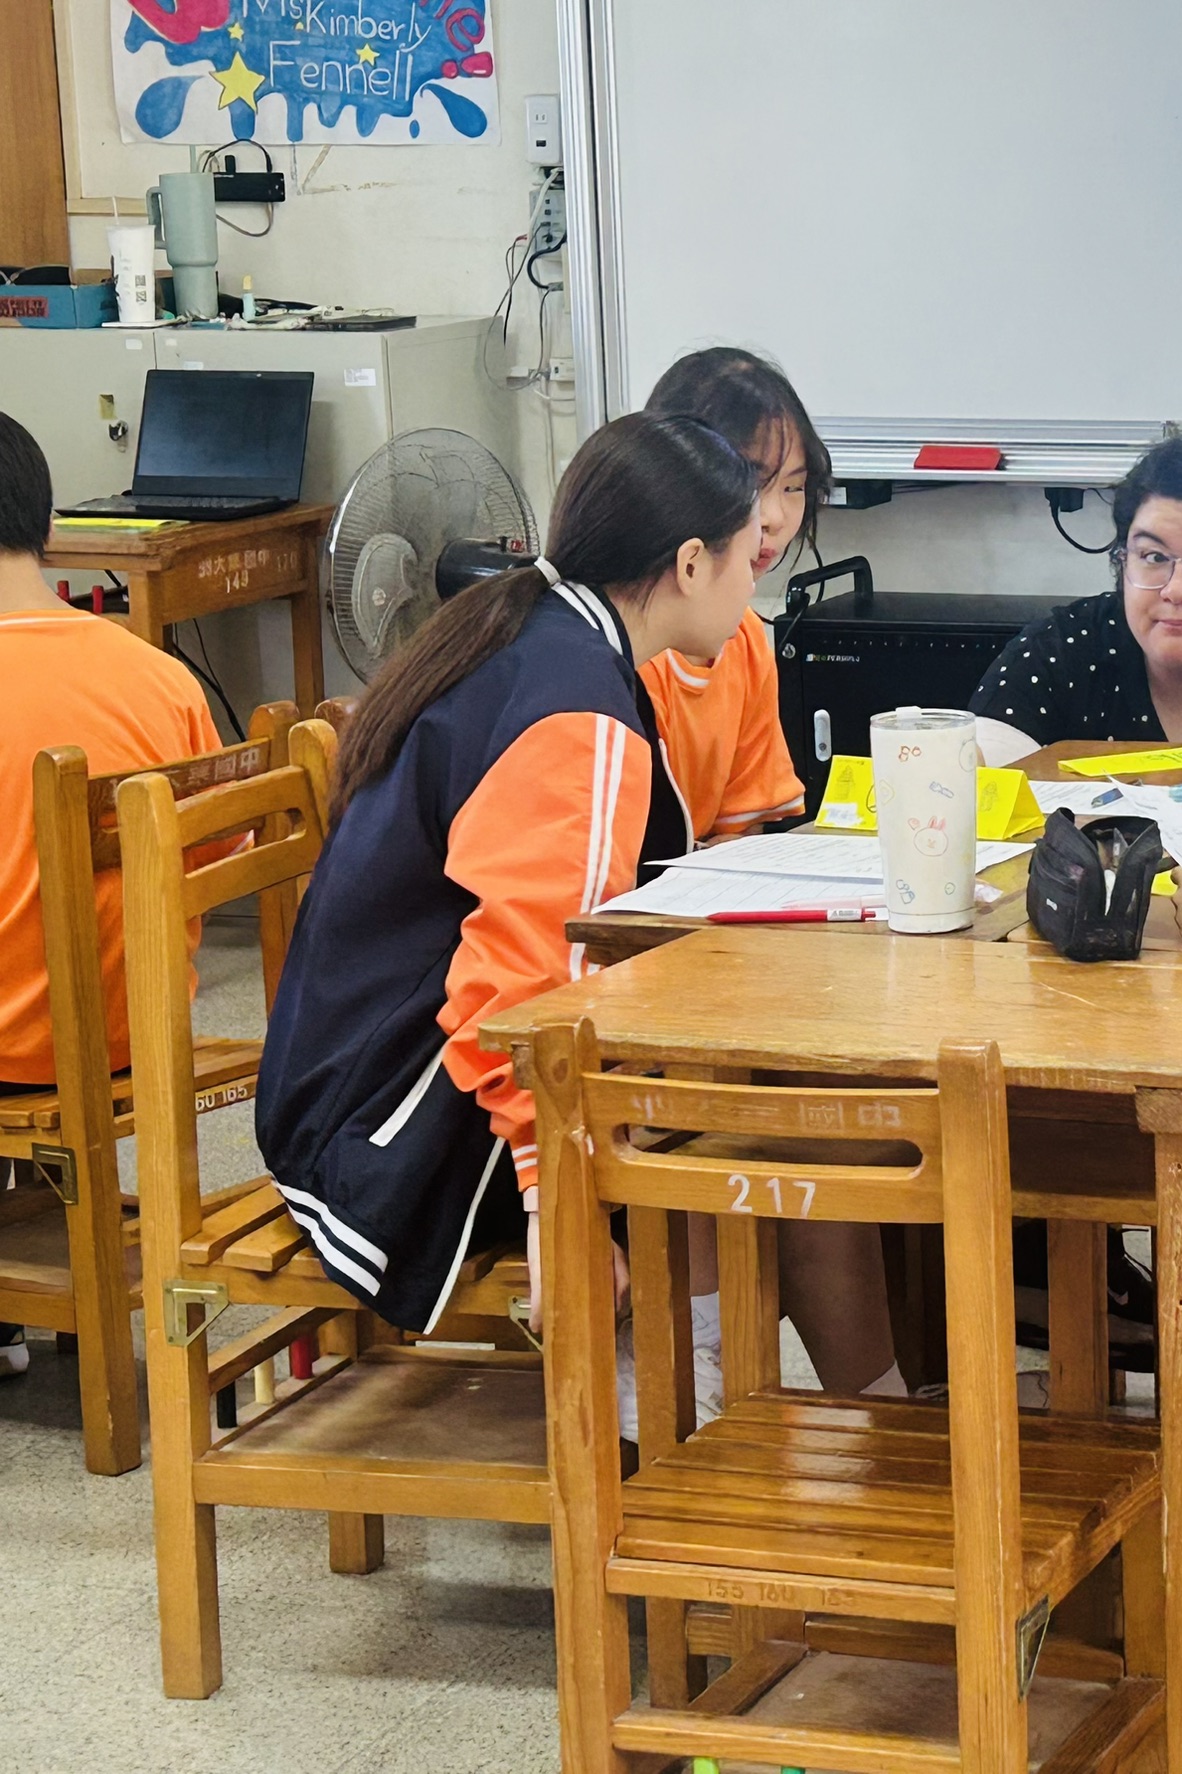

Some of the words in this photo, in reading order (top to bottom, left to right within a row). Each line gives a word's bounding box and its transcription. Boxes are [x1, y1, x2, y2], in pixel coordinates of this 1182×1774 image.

[306, 0, 431, 51] Kimberly
[269, 40, 413, 101] Fennell
[222, 1085, 247, 1104] 165
[728, 1174, 816, 1218] 217
